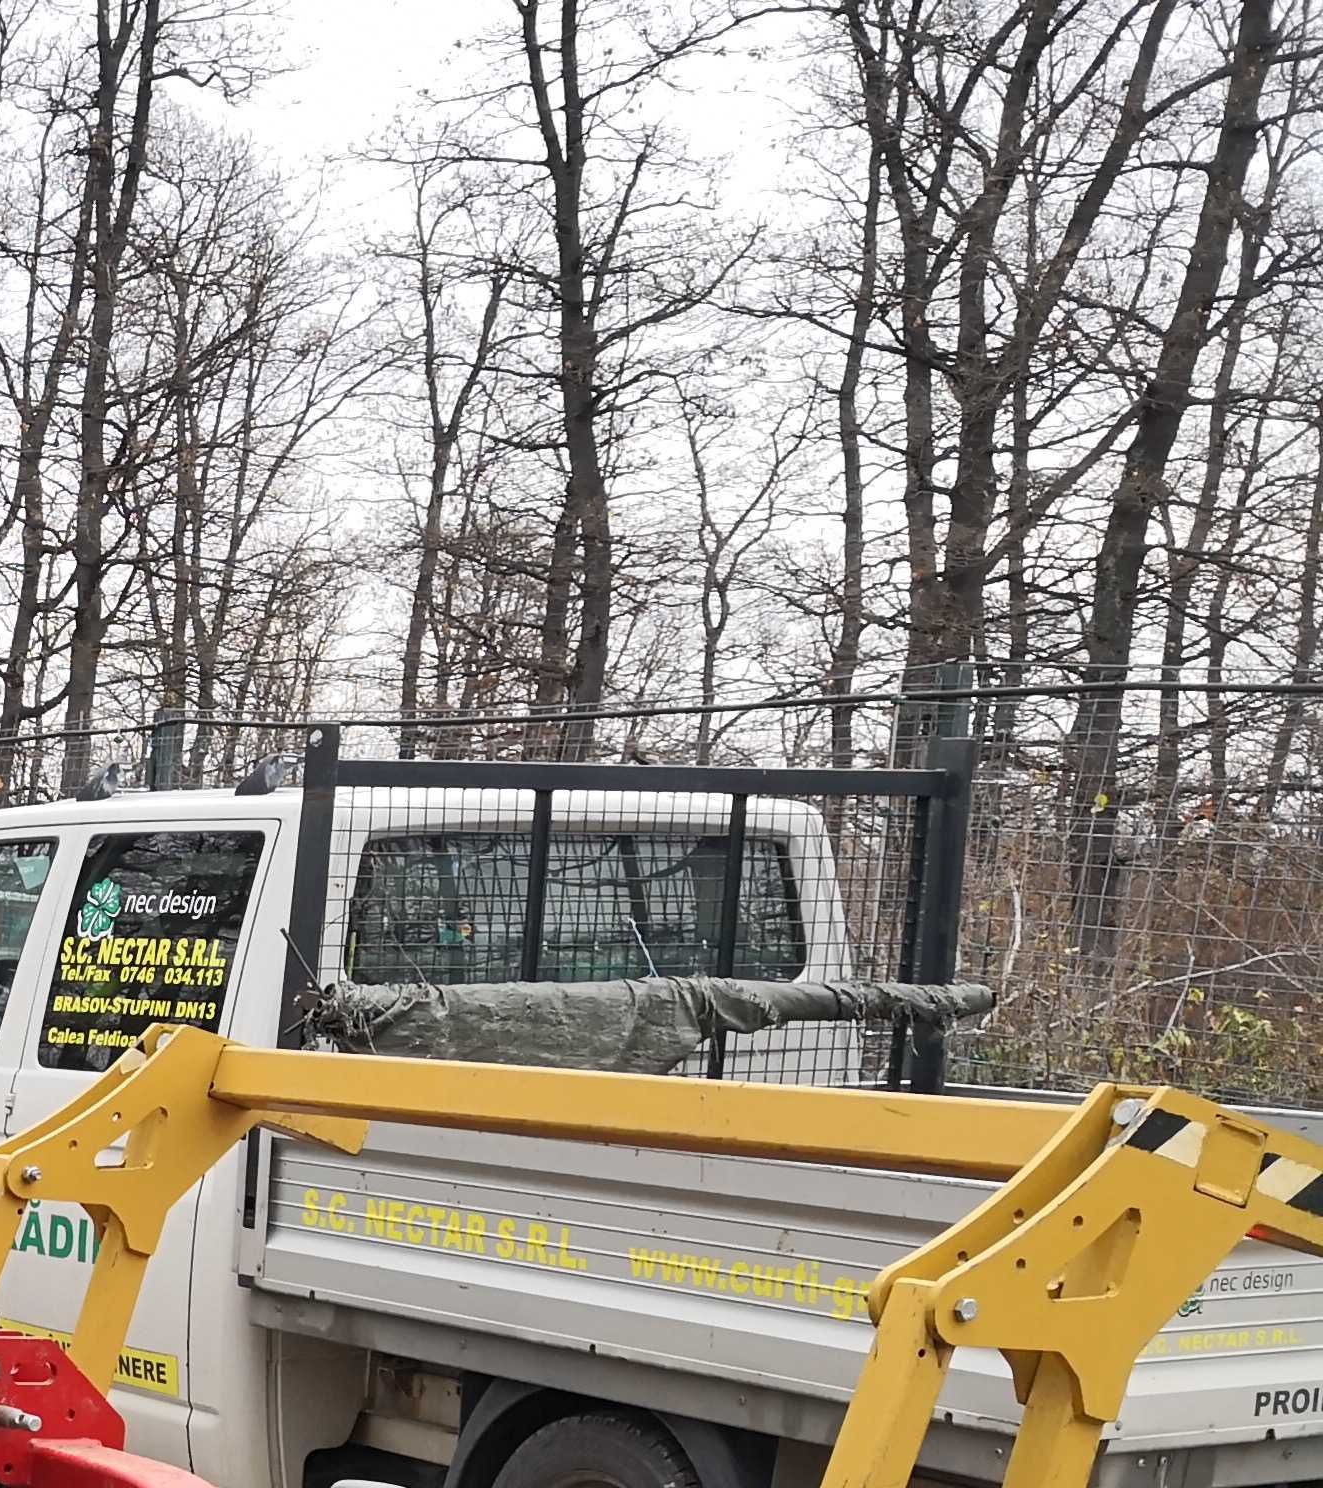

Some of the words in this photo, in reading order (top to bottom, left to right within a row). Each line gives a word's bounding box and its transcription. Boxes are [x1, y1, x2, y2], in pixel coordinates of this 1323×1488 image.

[124, 893, 156, 914] nec
[159, 889, 217, 920] design
[60, 937, 93, 964] S.C.
[97, 937, 171, 966] NECTAR
[173, 938, 227, 967] S.R.L.
[120, 966, 155, 984] 0746
[164, 967, 224, 987] 034.113
[53, 996, 170, 1018] BRASOV-STUPINI
[174, 1001, 217, 1020] DN13
[47, 1027, 85, 1045] Calea
[87, 1029, 138, 1048] Feldioa
[301, 1188, 355, 1233] S.C.
[365, 1198, 487, 1255] NECTAR
[495, 1216, 588, 1271] S.R.L.
[628, 1247, 872, 1321] www.curti-gr
[1209, 1274, 1238, 1293] nec
[1242, 1269, 1294, 1293] design
[1178, 1330, 1252, 1351] NECTAR
[1256, 1327, 1302, 1346] S.R.L.
[114, 1354, 167, 1385] NERE
[1254, 1387, 1323, 1417] PROI
